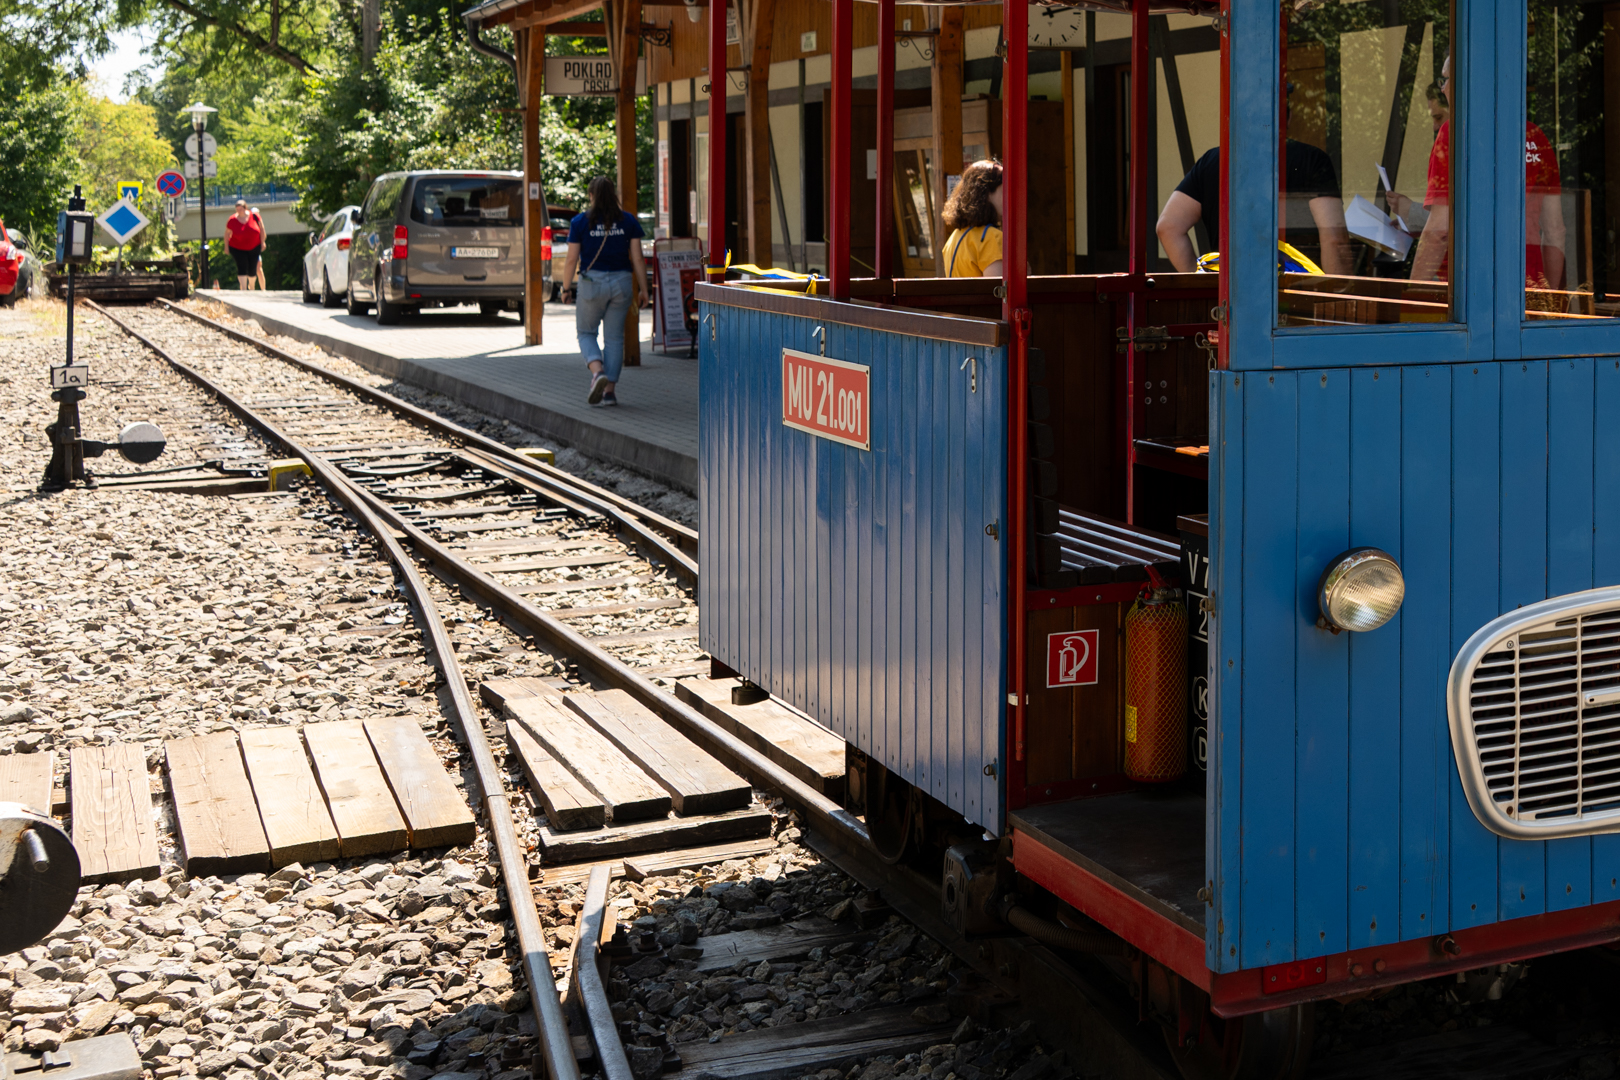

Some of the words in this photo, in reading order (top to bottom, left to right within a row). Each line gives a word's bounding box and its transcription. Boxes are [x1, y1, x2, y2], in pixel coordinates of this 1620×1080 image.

[564, 62, 612, 78] POKLAD
[583, 80, 610, 91] CASH
[59, 369, 81, 384] 1a
[788, 362, 813, 421] MU
[816, 370, 862, 436] 21.001
[1188, 551, 1199, 585] V
[1198, 685, 1208, 714] K
[1198, 735, 1208, 763] D
